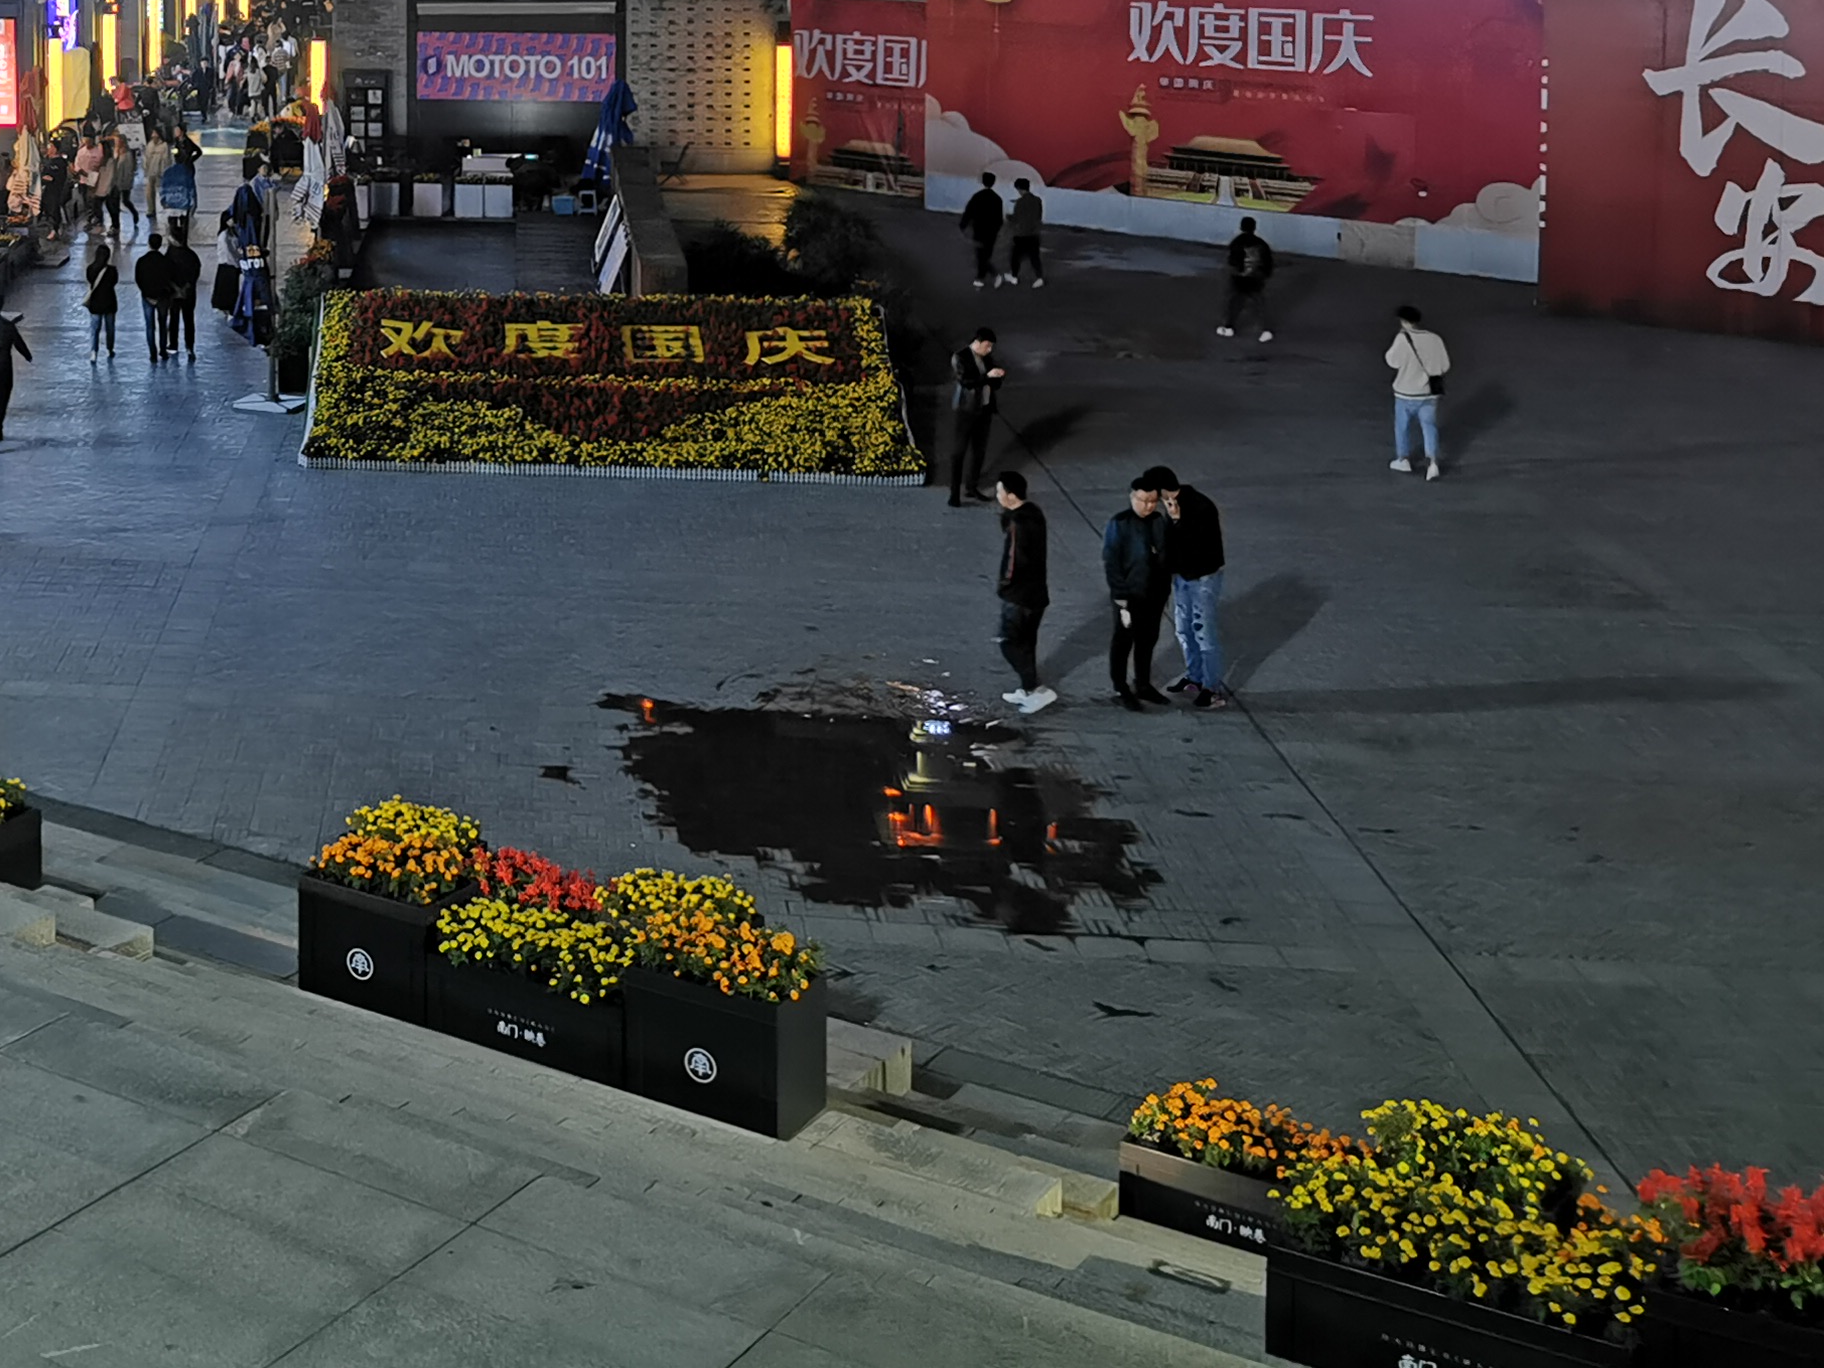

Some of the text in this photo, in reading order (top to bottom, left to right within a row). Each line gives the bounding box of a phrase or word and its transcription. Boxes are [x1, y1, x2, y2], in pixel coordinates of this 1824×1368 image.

[792, 29, 928, 88] 欢度国
[1128, 0, 1374, 78] 欢度国庆
[445, 54, 608, 80] MOTOTO 101
[379, 318, 836, 366] 欢度国庆
